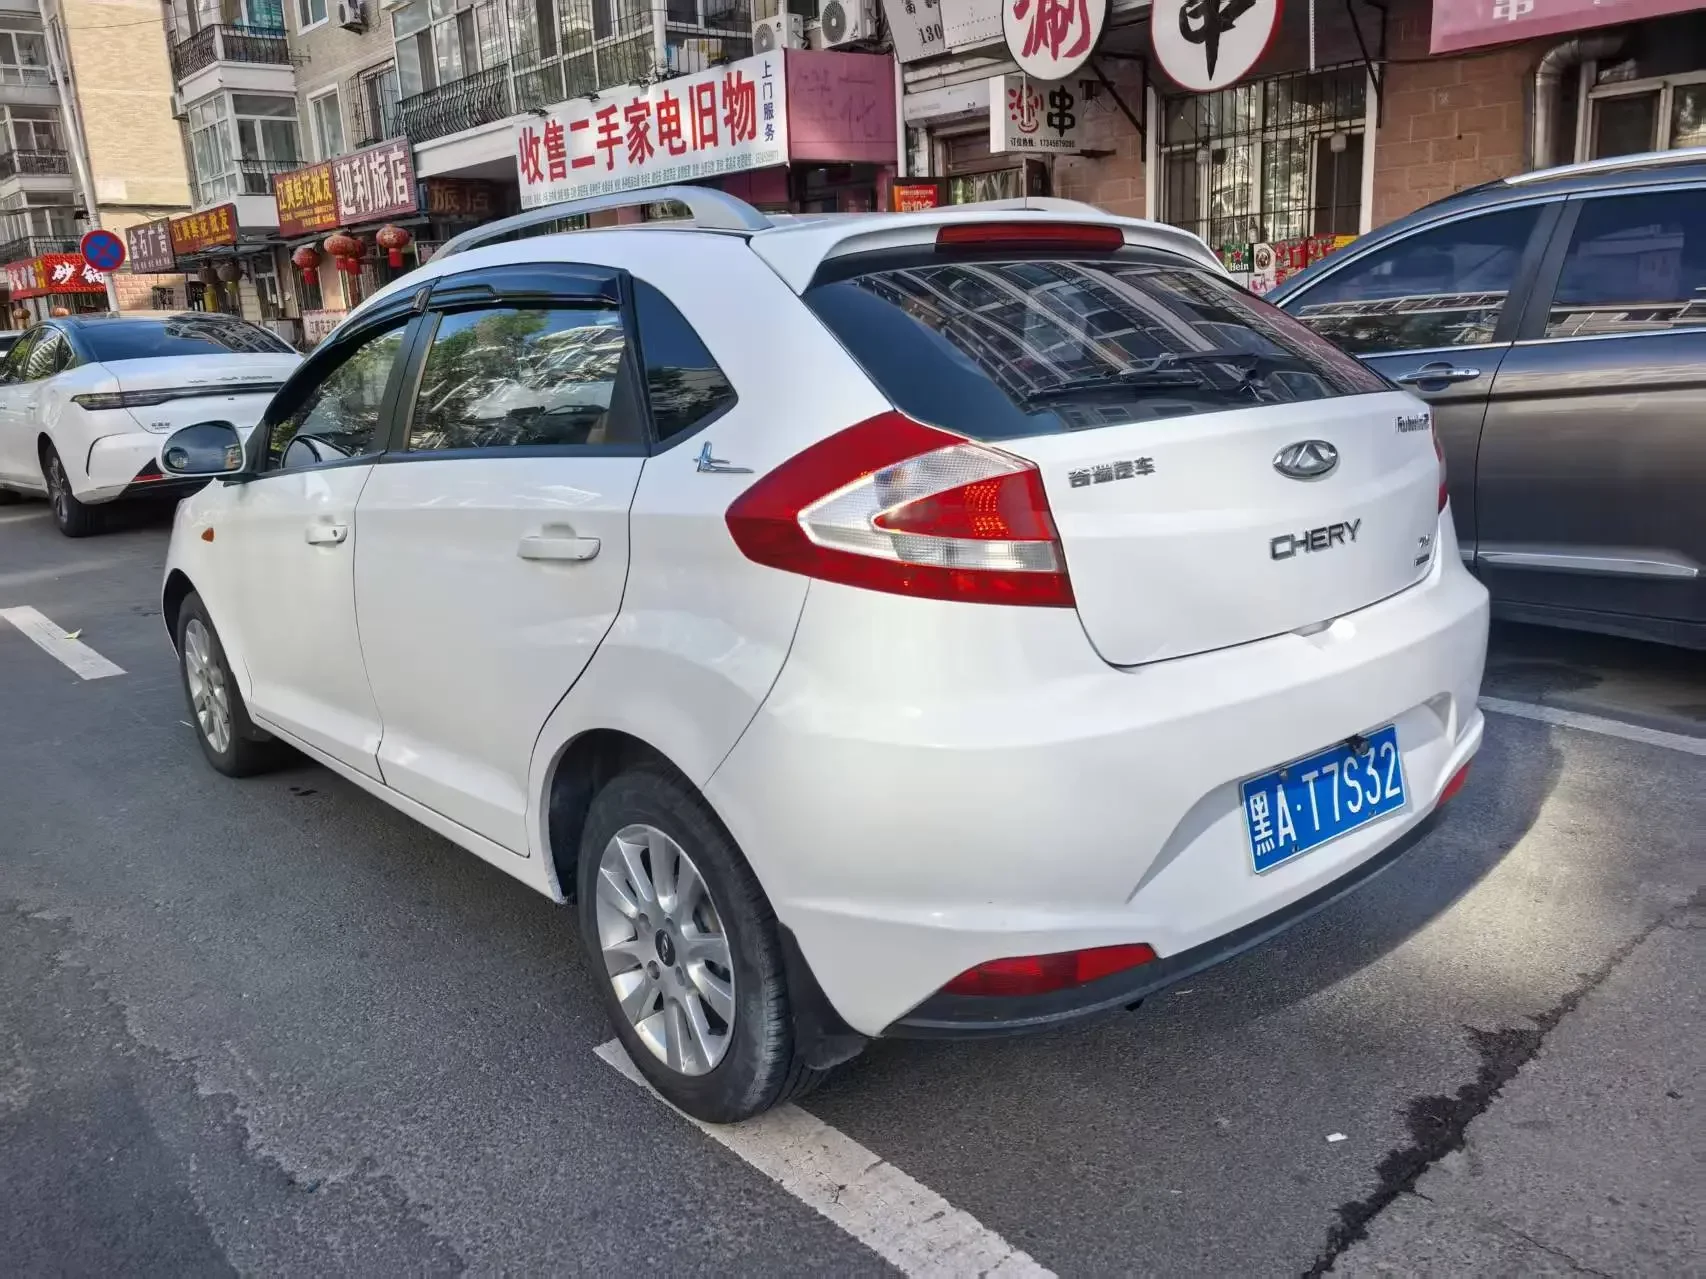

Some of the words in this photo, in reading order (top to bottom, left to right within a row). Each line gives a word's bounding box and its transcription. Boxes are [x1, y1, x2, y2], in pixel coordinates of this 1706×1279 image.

[518, 70, 758, 185] 收售二手家电旧物
[761, 60, 776, 143] 上门服务
[336, 144, 410, 216] 迎利旅店
[129, 222, 168, 260] 金石广告
[1269, 518, 1362, 561] CHERY
[1250, 741, 1401, 857] 黑A·T7S32
